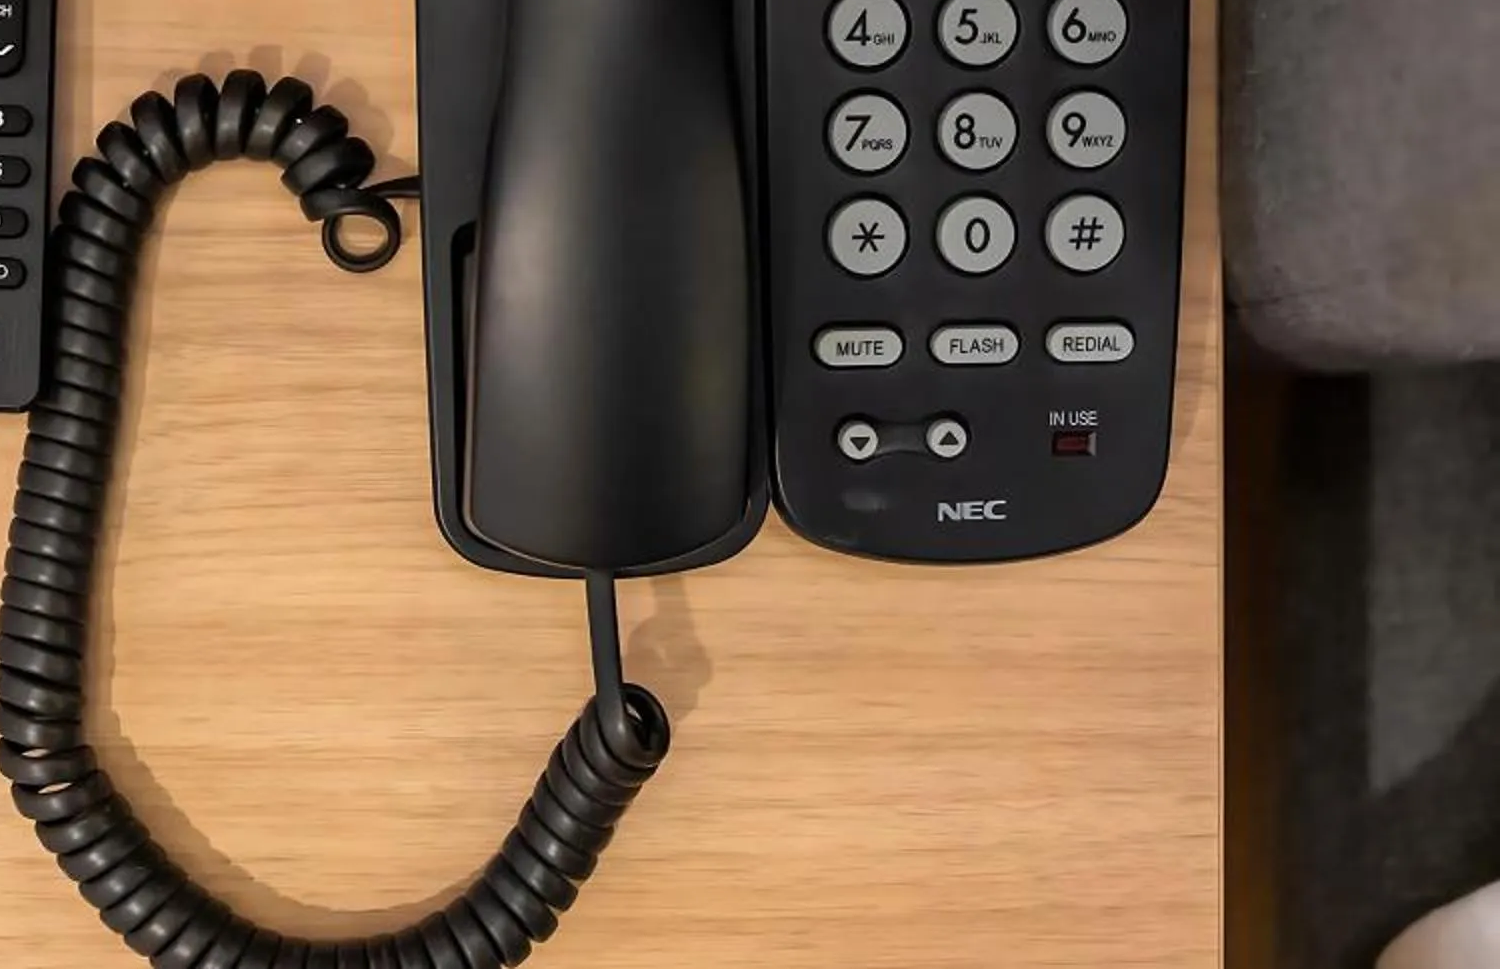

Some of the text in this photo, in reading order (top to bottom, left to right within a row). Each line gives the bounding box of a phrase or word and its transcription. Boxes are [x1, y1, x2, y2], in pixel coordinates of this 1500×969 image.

[843, 8, 895, 47] 4 GHI
[954, 8, 1003, 46] 5 JKL
[1061, 7, 1117, 44] 6 MNO
[845, 114, 893, 152] 7 PQRS
[953, 112, 1003, 150] 8 TUV
[1061, 111, 1114, 148] 9 WXYZ
[964, 216, 991, 254] 0
[835, 340, 884, 357] MUTE
[949, 337, 1005, 355] FLASH
[1062, 336, 1121, 352] REDIAL
[1049, 410, 1098, 426] IN USE
[937, 499, 1007, 522] NEC
